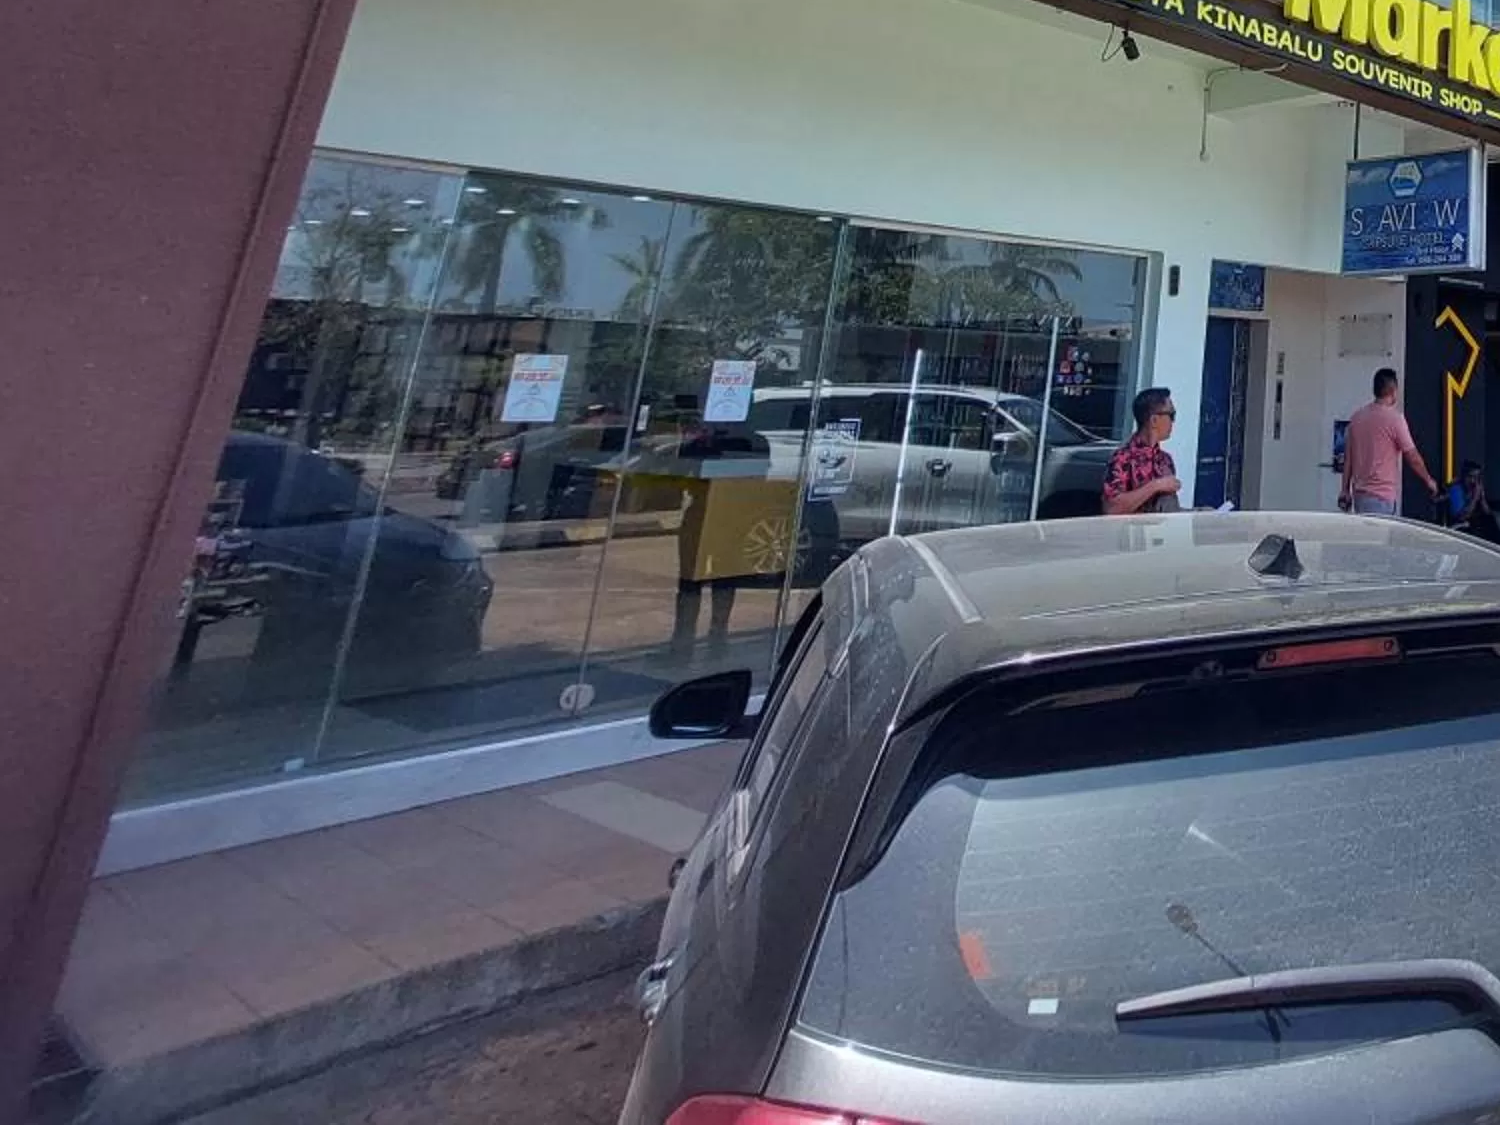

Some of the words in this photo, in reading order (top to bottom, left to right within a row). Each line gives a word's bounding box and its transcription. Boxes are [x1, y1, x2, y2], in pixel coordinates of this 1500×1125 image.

[1197, 0, 1324, 62] KINABALU
[1332, 49, 1434, 102] SOUVENIR
[1439, 87, 1484, 118] SHOP
